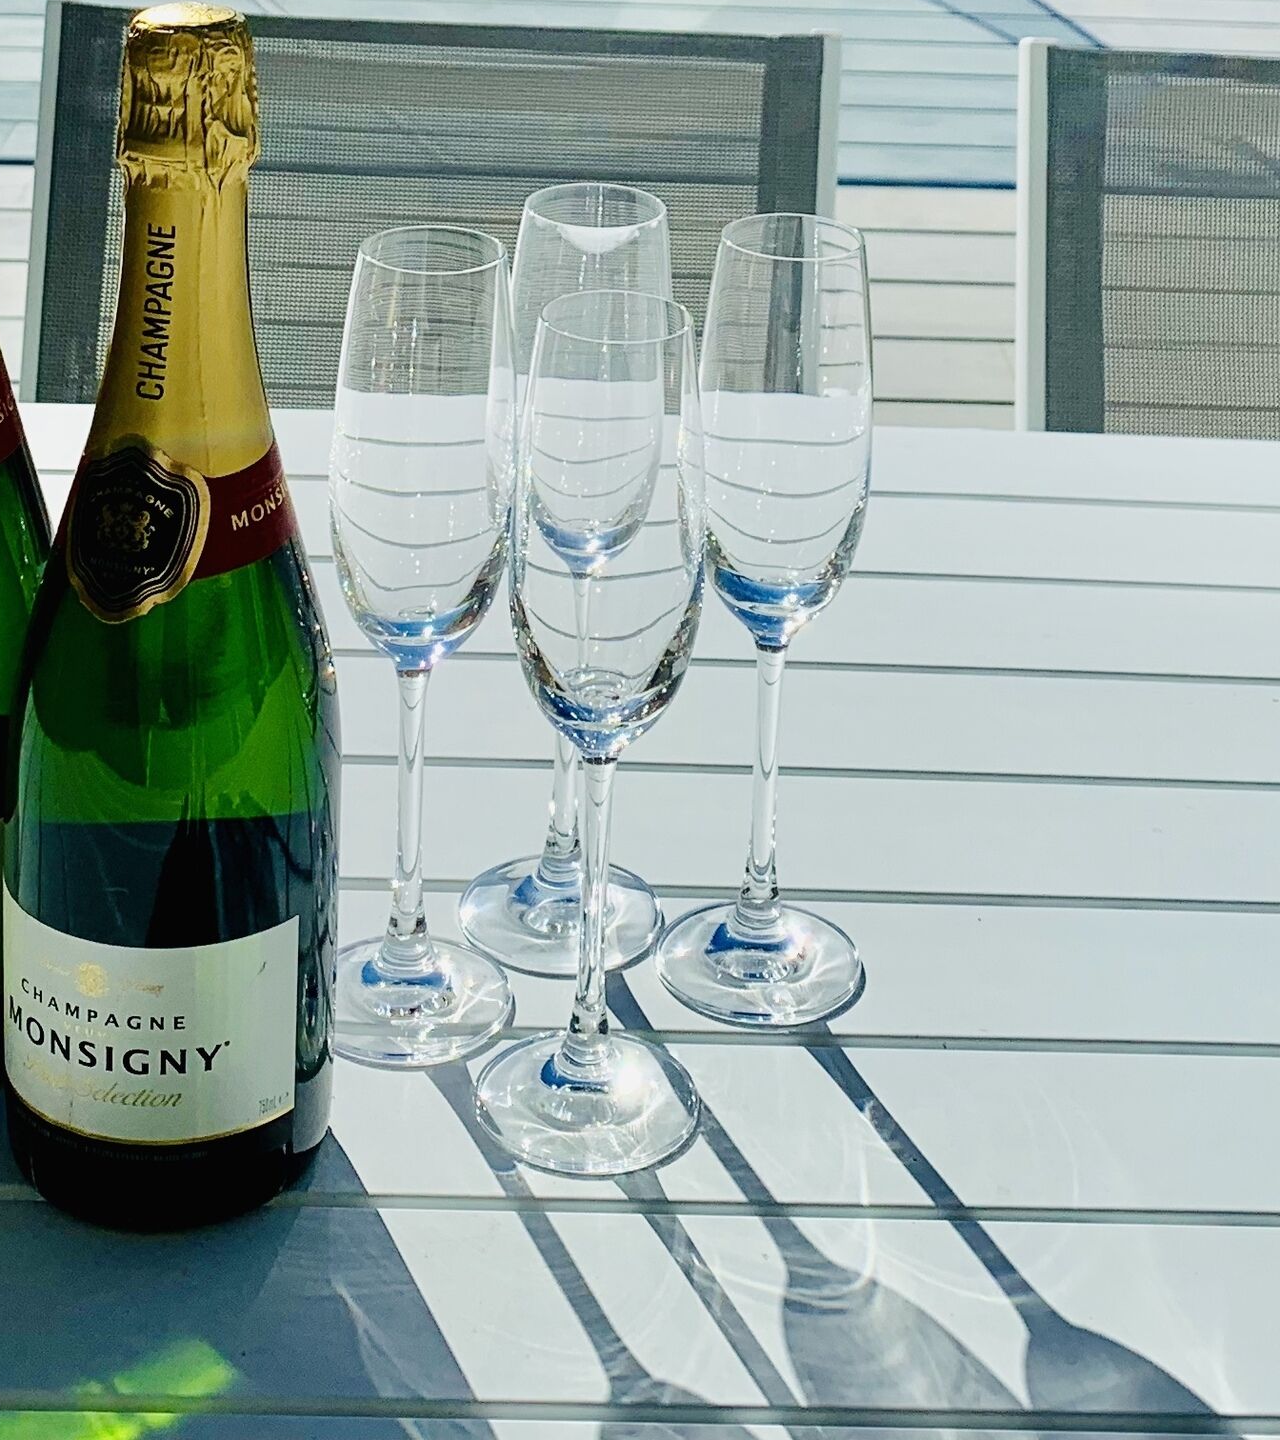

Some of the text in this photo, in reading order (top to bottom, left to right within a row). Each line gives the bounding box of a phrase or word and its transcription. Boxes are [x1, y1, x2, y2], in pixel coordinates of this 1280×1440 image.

[136, 222, 176, 401] CHAMPAGNE
[9, 994, 230, 1076] MONSIGNY
[21, 977, 186, 1030] CHAMPAGNE
